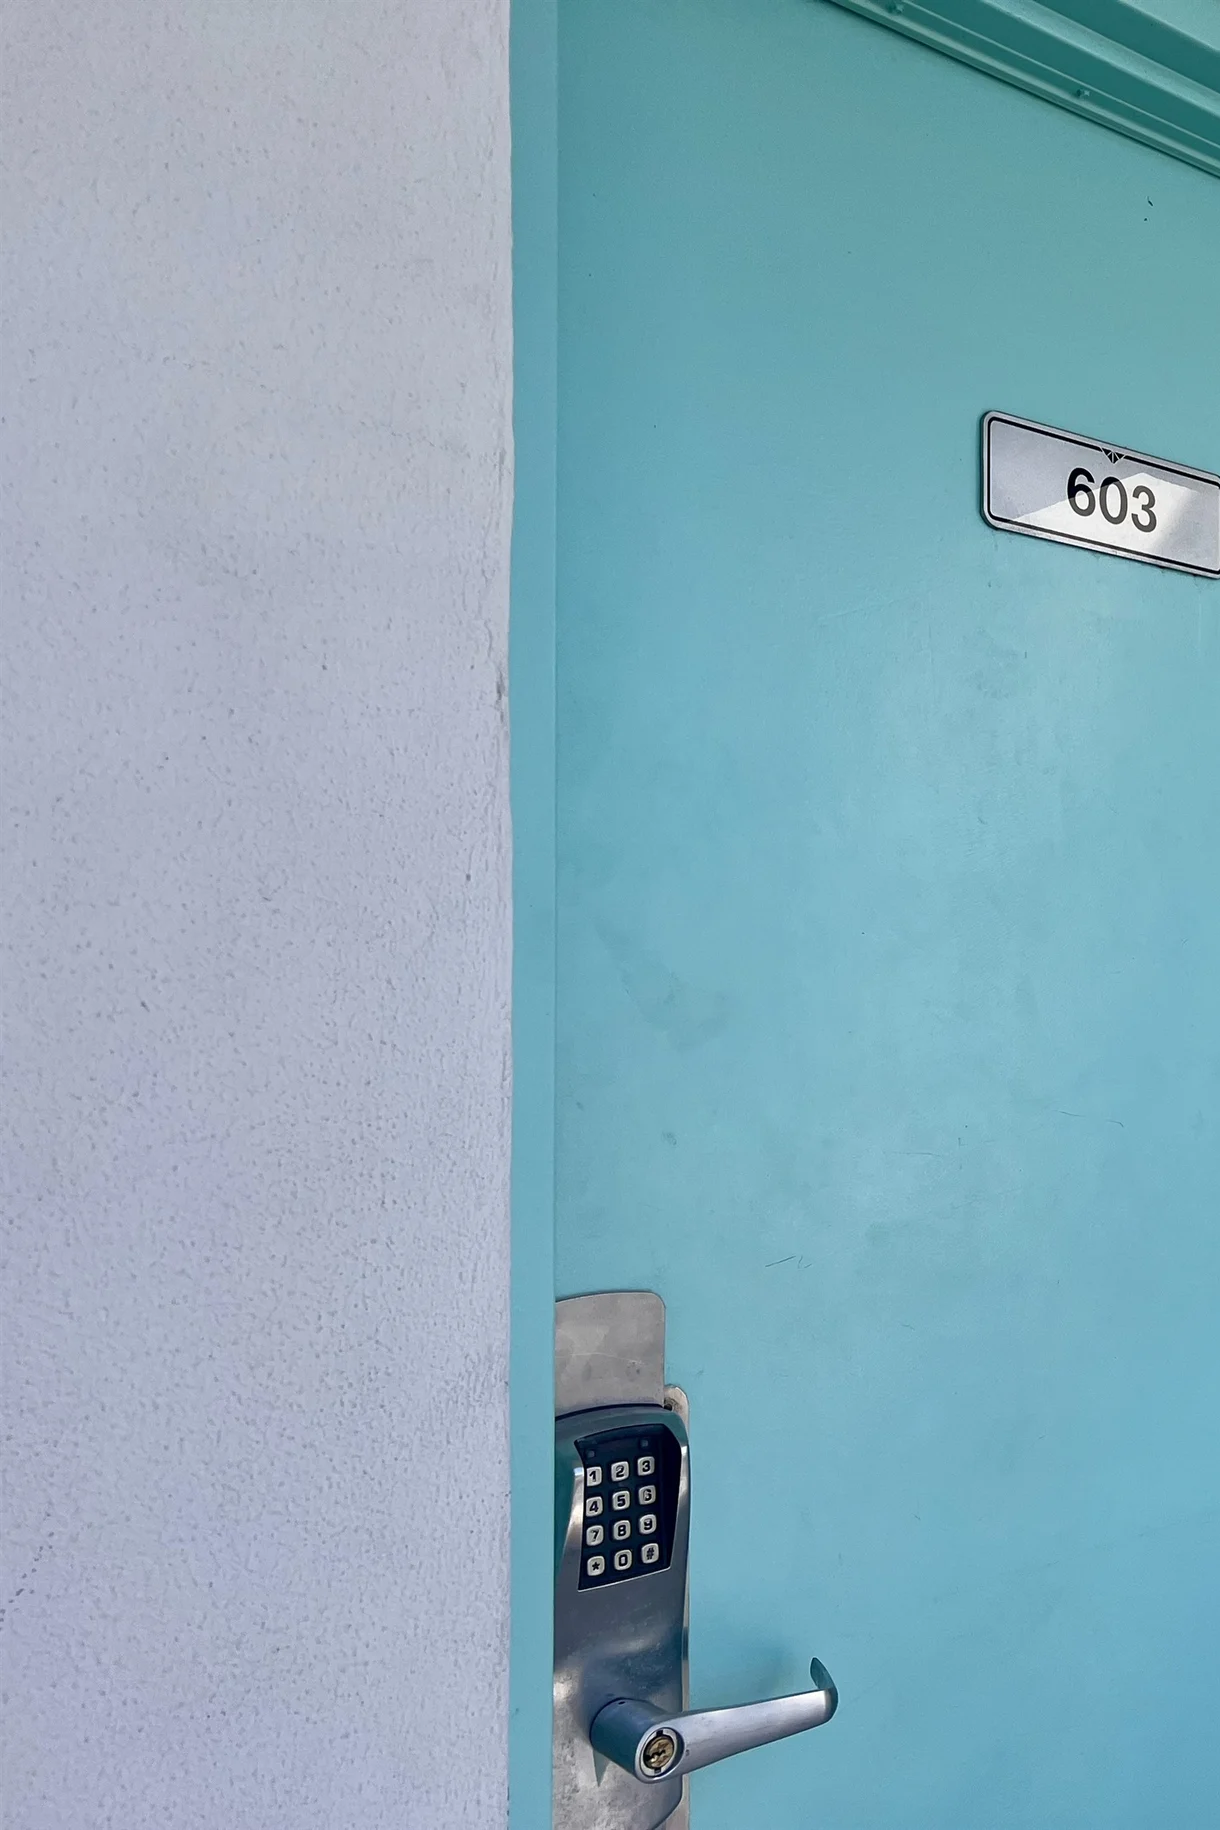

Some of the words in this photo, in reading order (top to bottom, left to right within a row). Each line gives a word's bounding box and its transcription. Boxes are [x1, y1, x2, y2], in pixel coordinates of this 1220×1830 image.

[1067, 467, 1157, 533] 603
[589, 1470, 597, 1482] 1
[616, 1465, 624, 1477] 2
[642, 1460, 650, 1472] 3
[589, 1500, 599, 1513] 4
[617, 1494, 626, 1507] 5
[643, 1489, 652, 1501] 6
[590, 1529, 599, 1542] 7
[617, 1524, 626, 1537] 8
[644, 1518, 652, 1531] 9
